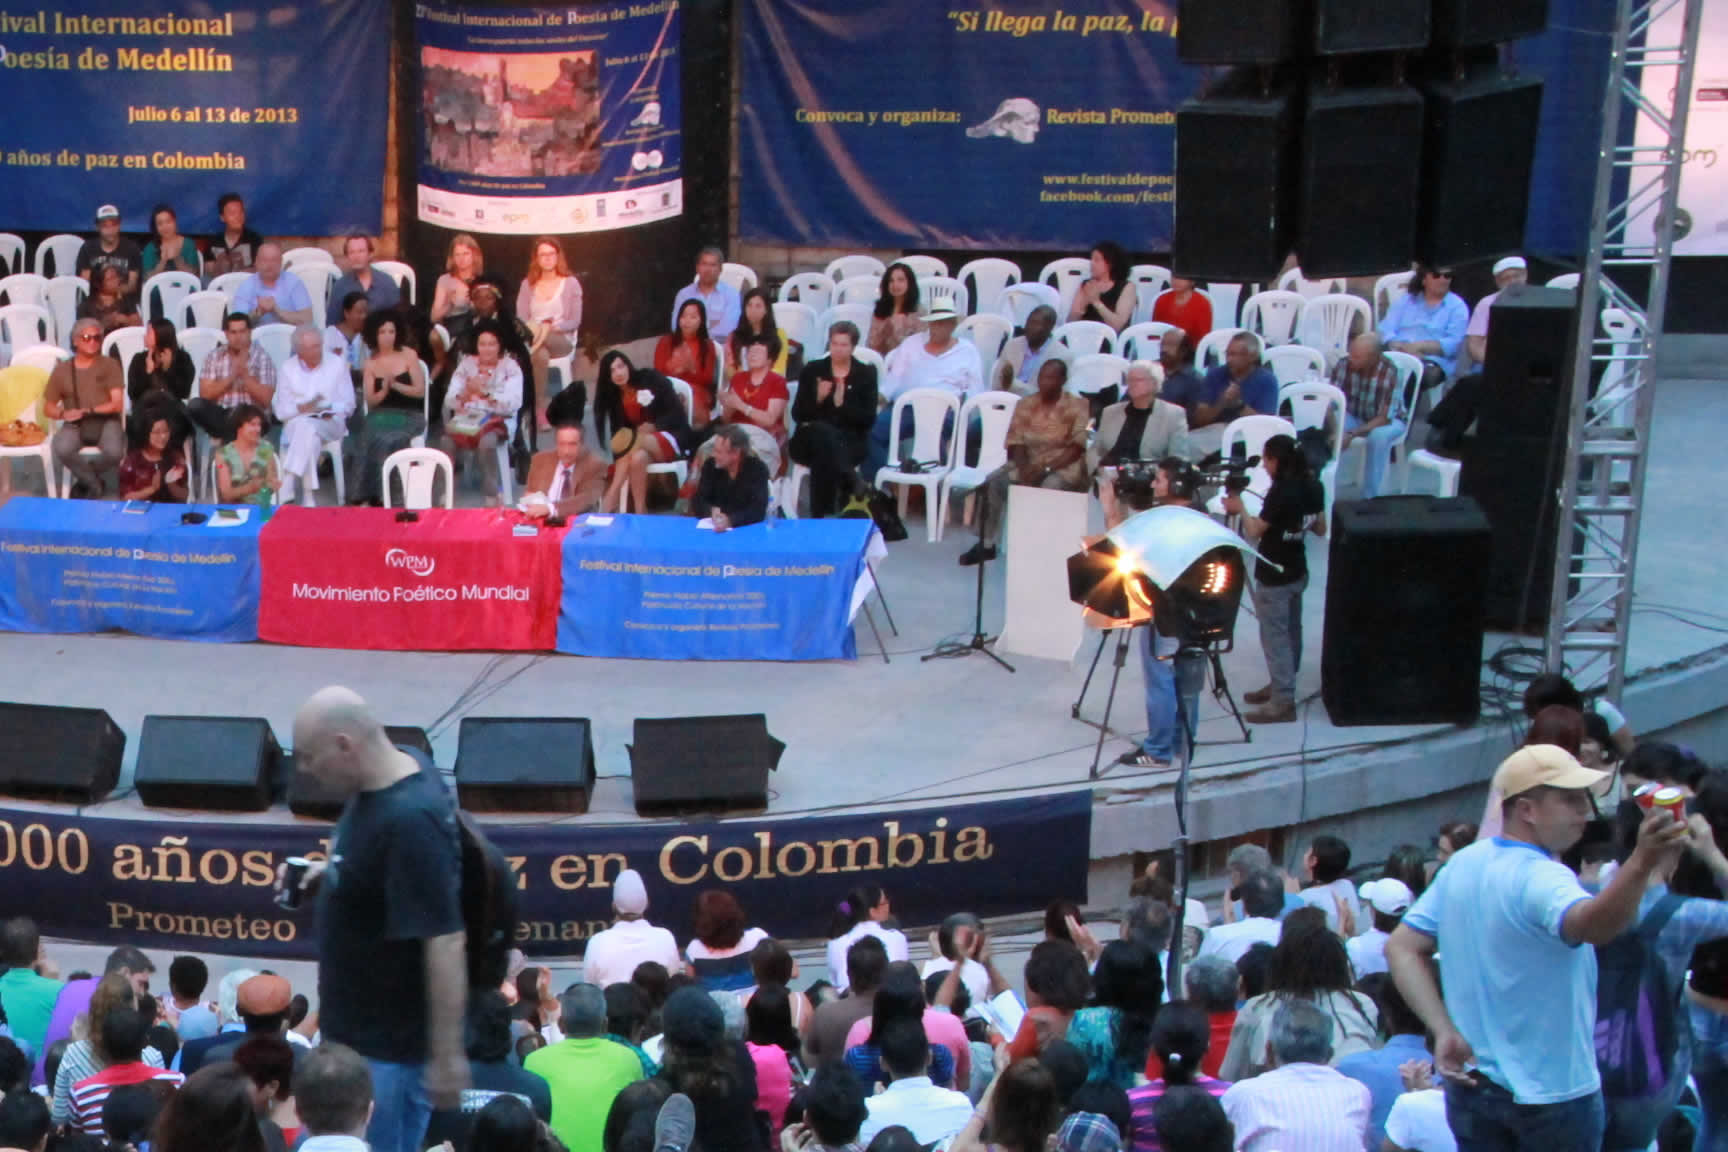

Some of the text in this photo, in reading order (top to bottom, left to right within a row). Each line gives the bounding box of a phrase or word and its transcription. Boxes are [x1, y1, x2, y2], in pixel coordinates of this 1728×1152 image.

[55, 12, 233, 36] Internacional
[463, 14, 544, 27] Internacional
[547, 13, 563, 26] de
[610, 9, 626, 21] de
[985, 11, 1046, 37] llega
[1052, 10, 1076, 32] la
[1082, 14, 1134, 37] paz,
[1141, 10, 1165, 32] la
[78, 48, 110, 70] de
[117, 47, 233, 71] Medellín
[128, 106, 298, 124] Julio 6 al 13 de 2013
[795, 109, 864, 124] Convoca
[868, 110, 878, 126] y
[882, 109, 961, 127] organiza:
[1047, 108, 1107, 124] Revista
[7, 148, 52, 167] años
[56, 149, 80, 167] de
[85, 153, 119, 171] paz
[123, 154, 147, 169] en
[151, 151, 246, 171] Colombia
[579, 559, 622, 572] Festival
[624, 562, 702, 577] Internacional
[703, 565, 721, 577] de
[765, 565, 781, 576] de
[292, 583, 391, 602] Movimiento
[461, 583, 530, 602] Mundial
[112, 837, 275, 888] años
[550, 853, 629, 890] en
[659, 817, 993, 886] Colombia
[107, 902, 297, 942] Prometeo
